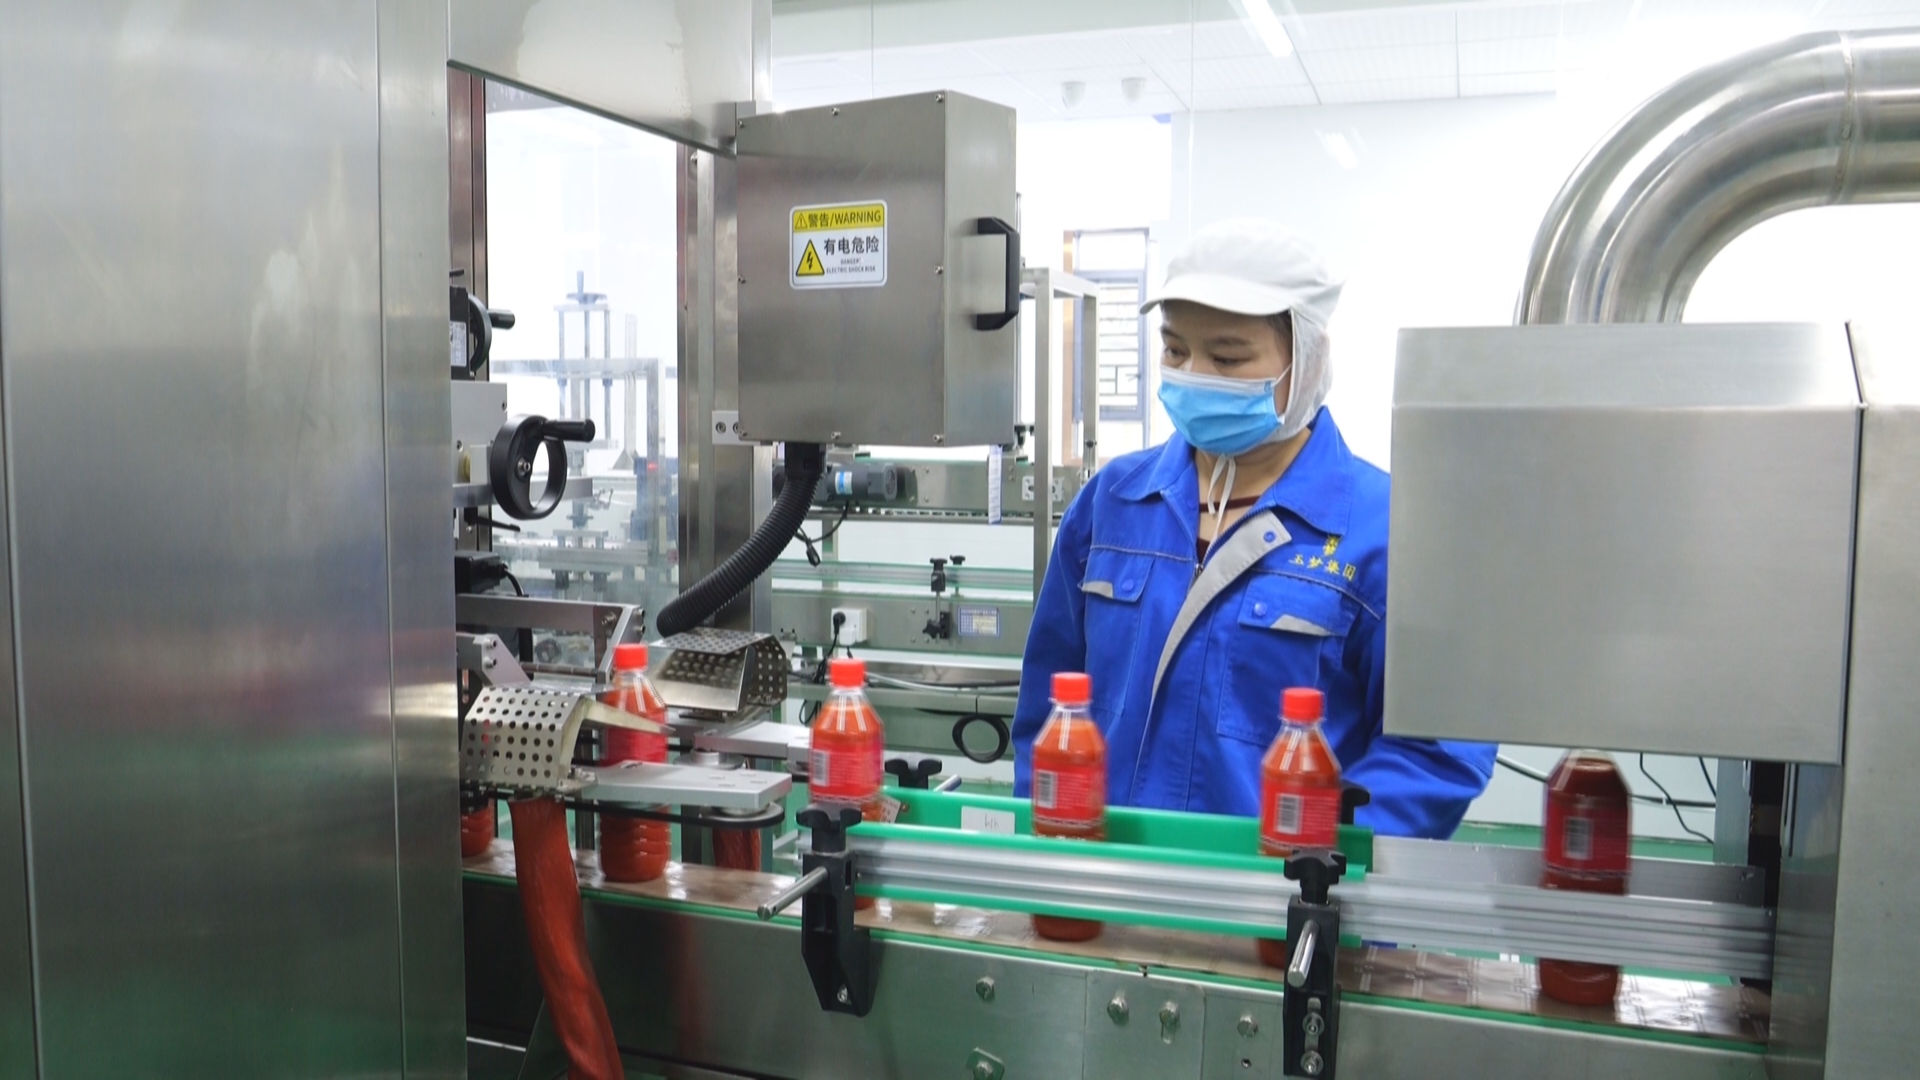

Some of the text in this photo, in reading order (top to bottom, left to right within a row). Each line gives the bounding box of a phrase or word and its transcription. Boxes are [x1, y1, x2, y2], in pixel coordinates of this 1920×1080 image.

[824, 235, 879, 255] 有电危险
[826, 266, 848, 274] ELECTRIC
[848, 265, 864, 273] SHOCK
